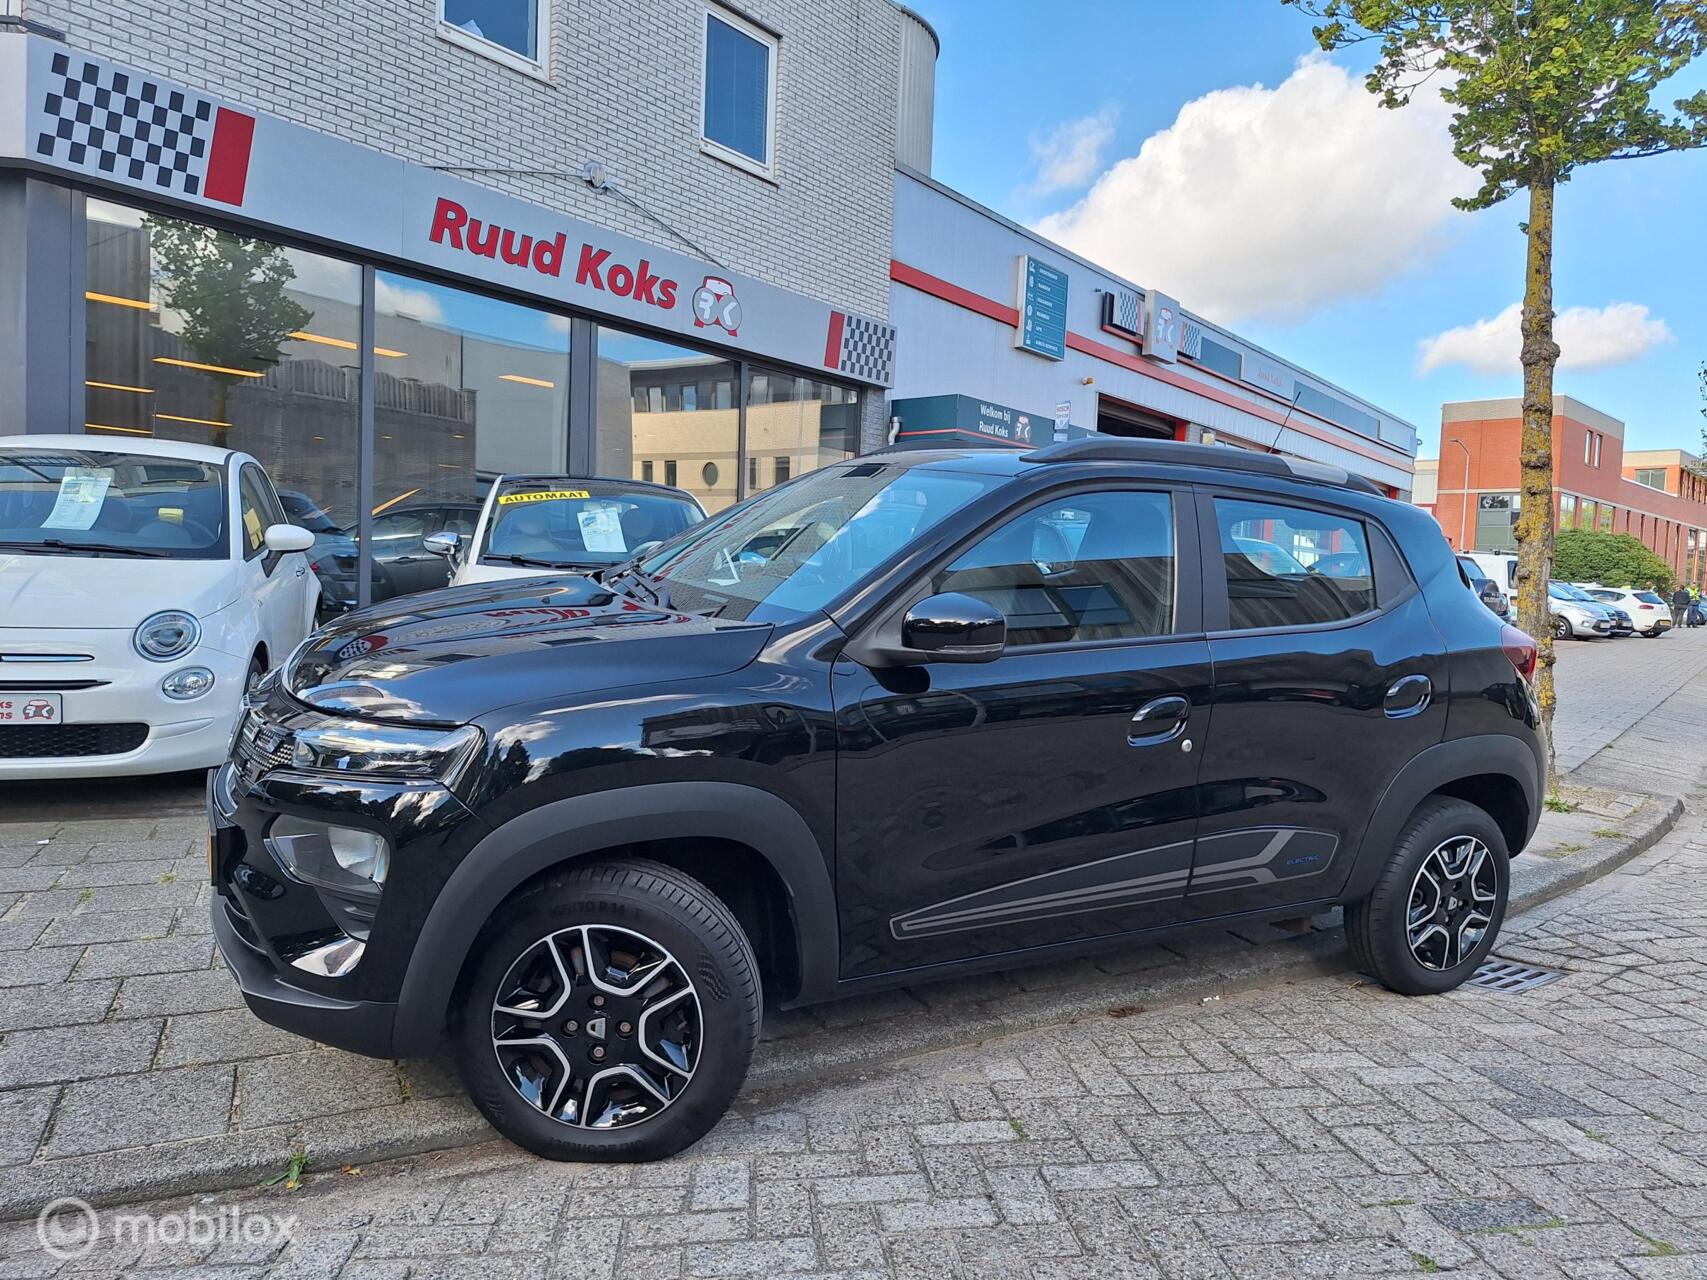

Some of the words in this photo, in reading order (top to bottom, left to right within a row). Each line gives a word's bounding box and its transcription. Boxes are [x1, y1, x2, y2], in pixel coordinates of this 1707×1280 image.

[429, 197, 568, 278] Ruud
[575, 243, 678, 311] Koks
[980, 404, 1003, 420] Welkom
[1003, 409, 1011, 424] bij
[979, 421, 994, 434] Ruud
[994, 424, 1008, 437] Koks
[505, 491, 584, 503] AUTOMAAT
